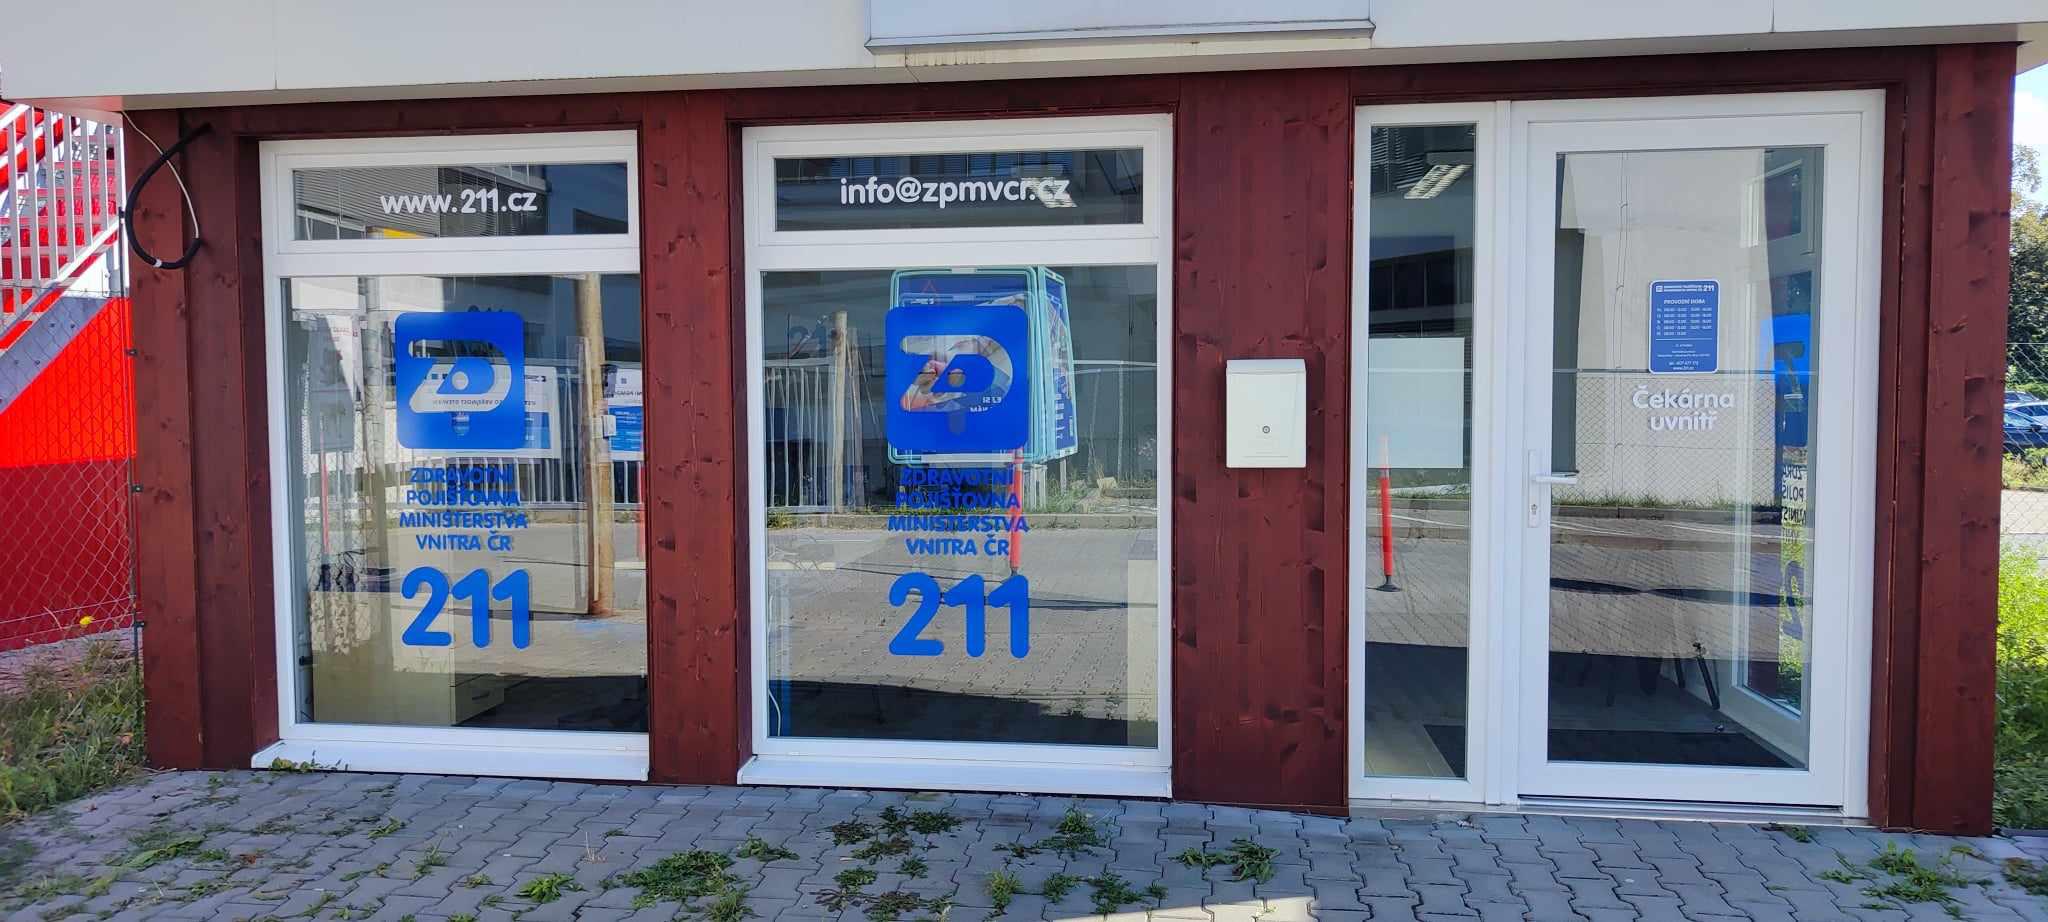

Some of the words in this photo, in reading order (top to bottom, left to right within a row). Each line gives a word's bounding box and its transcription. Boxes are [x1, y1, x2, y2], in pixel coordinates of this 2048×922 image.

[380, 188, 537, 214] www.211.cz
[840, 176, 1070, 208] info@zpmvcr.cz
[1632, 384, 1735, 409] Čekárna
[1650, 410, 1717, 431] uvnitř
[410, 464, 516, 484] ZDRAVOTNÍ
[900, 464, 1015, 486] ZDRAVOTNÍ
[406, 484, 520, 507] POJIŠŤOVNA
[895, 486, 1021, 509] POJIŠŤOVNA
[399, 511, 528, 529] MINISTERSTVA
[887, 514, 1030, 533] MINISTERSTVA
[416, 534, 481, 551] VNITRA
[487, 531, 513, 551] ČR
[905, 538, 977, 556] VNITRA
[984, 534, 1010, 556] ČR
[401, 566, 530, 649] 211
[889, 572, 1029, 658] 211
